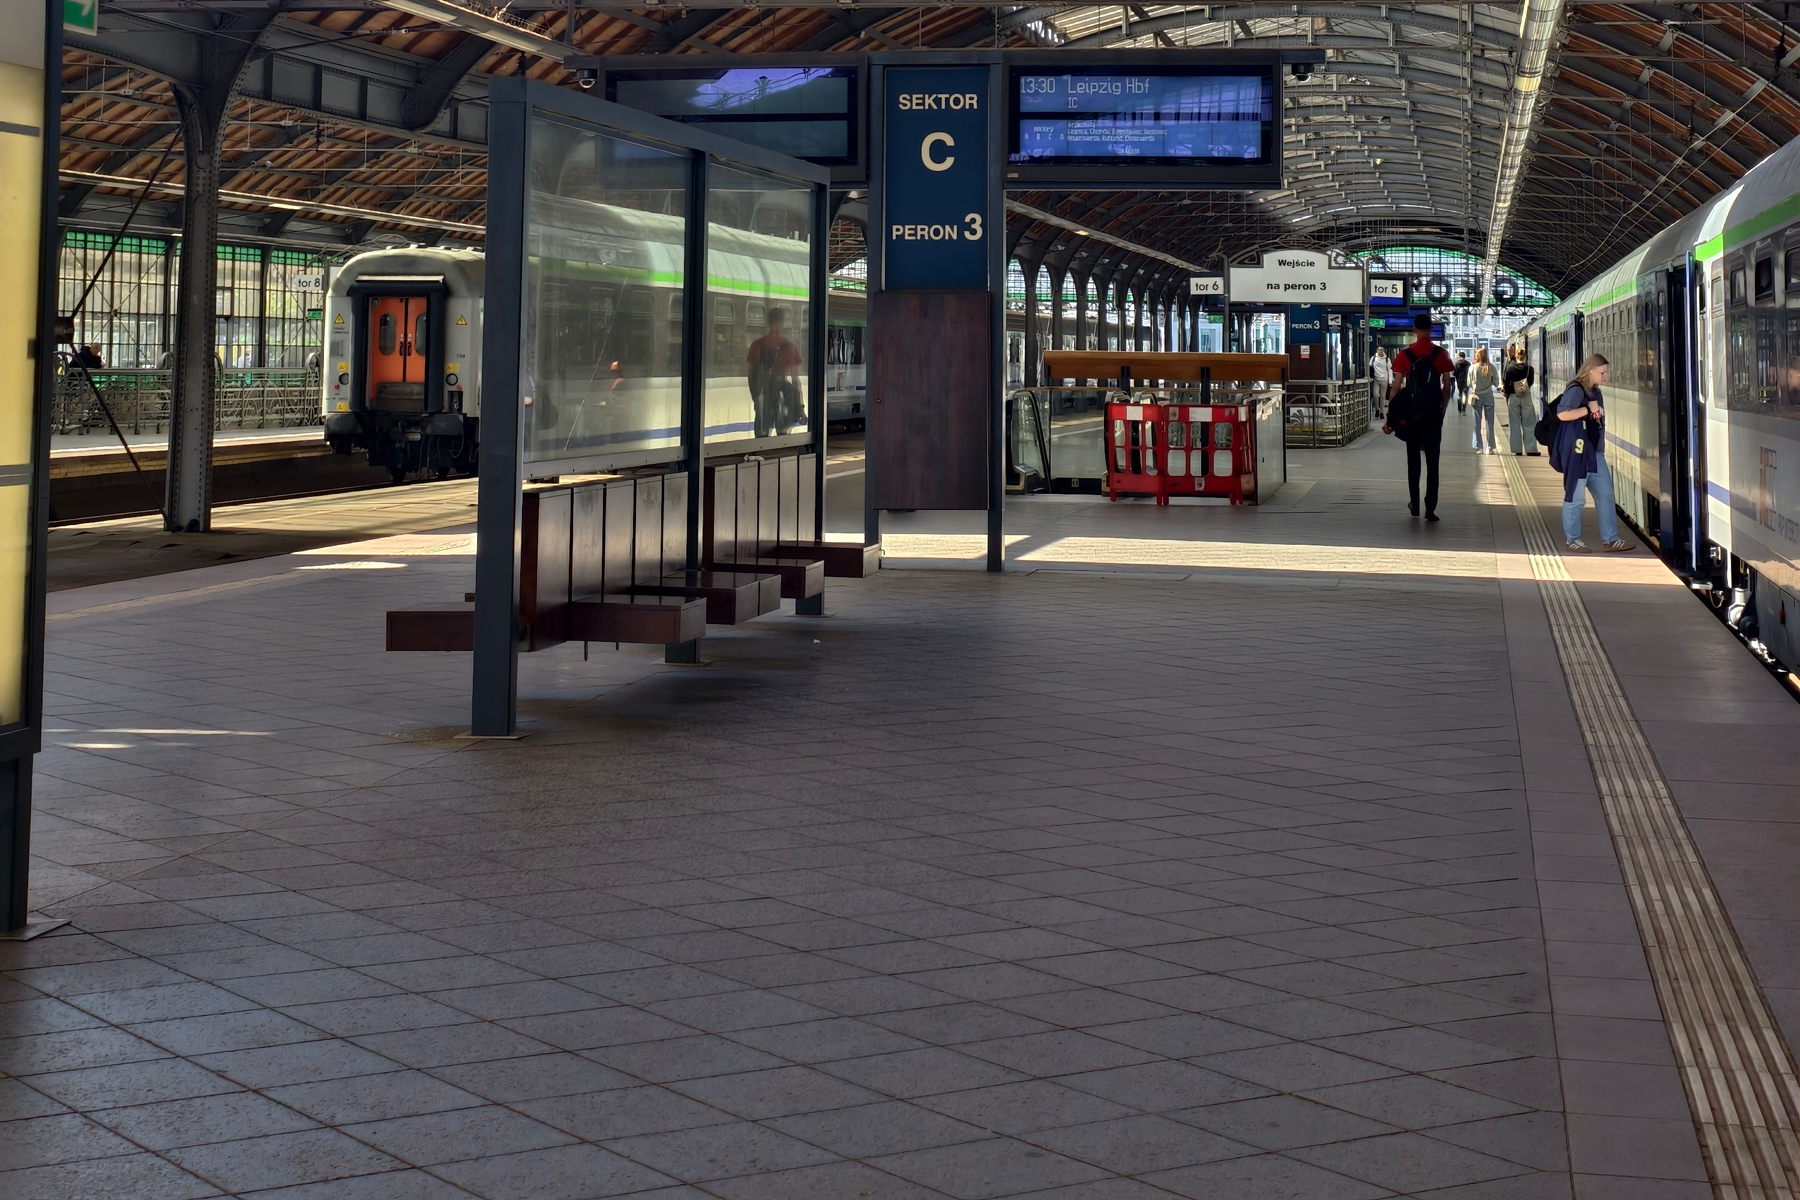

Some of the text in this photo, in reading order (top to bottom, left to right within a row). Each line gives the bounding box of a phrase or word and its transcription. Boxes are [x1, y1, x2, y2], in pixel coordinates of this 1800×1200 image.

[1021, 78, 1150, 95] 13:30 Leipzig Hbf
[898, 93, 978, 110] SEKTOR
[1068, 97, 1078, 109] IC
[920, 131, 956, 172] C
[892, 212, 983, 241] PERON 3
[1277, 258, 1316, 270] Wejście
[298, 278, 321, 288] tor 8
[1195, 280, 1219, 292] tor 6
[1266, 281, 1327, 293] na peron 3
[1373, 283, 1398, 294] tor 5
[1313, 320, 1321, 330] 3
[1575, 438, 1584, 454] 9
